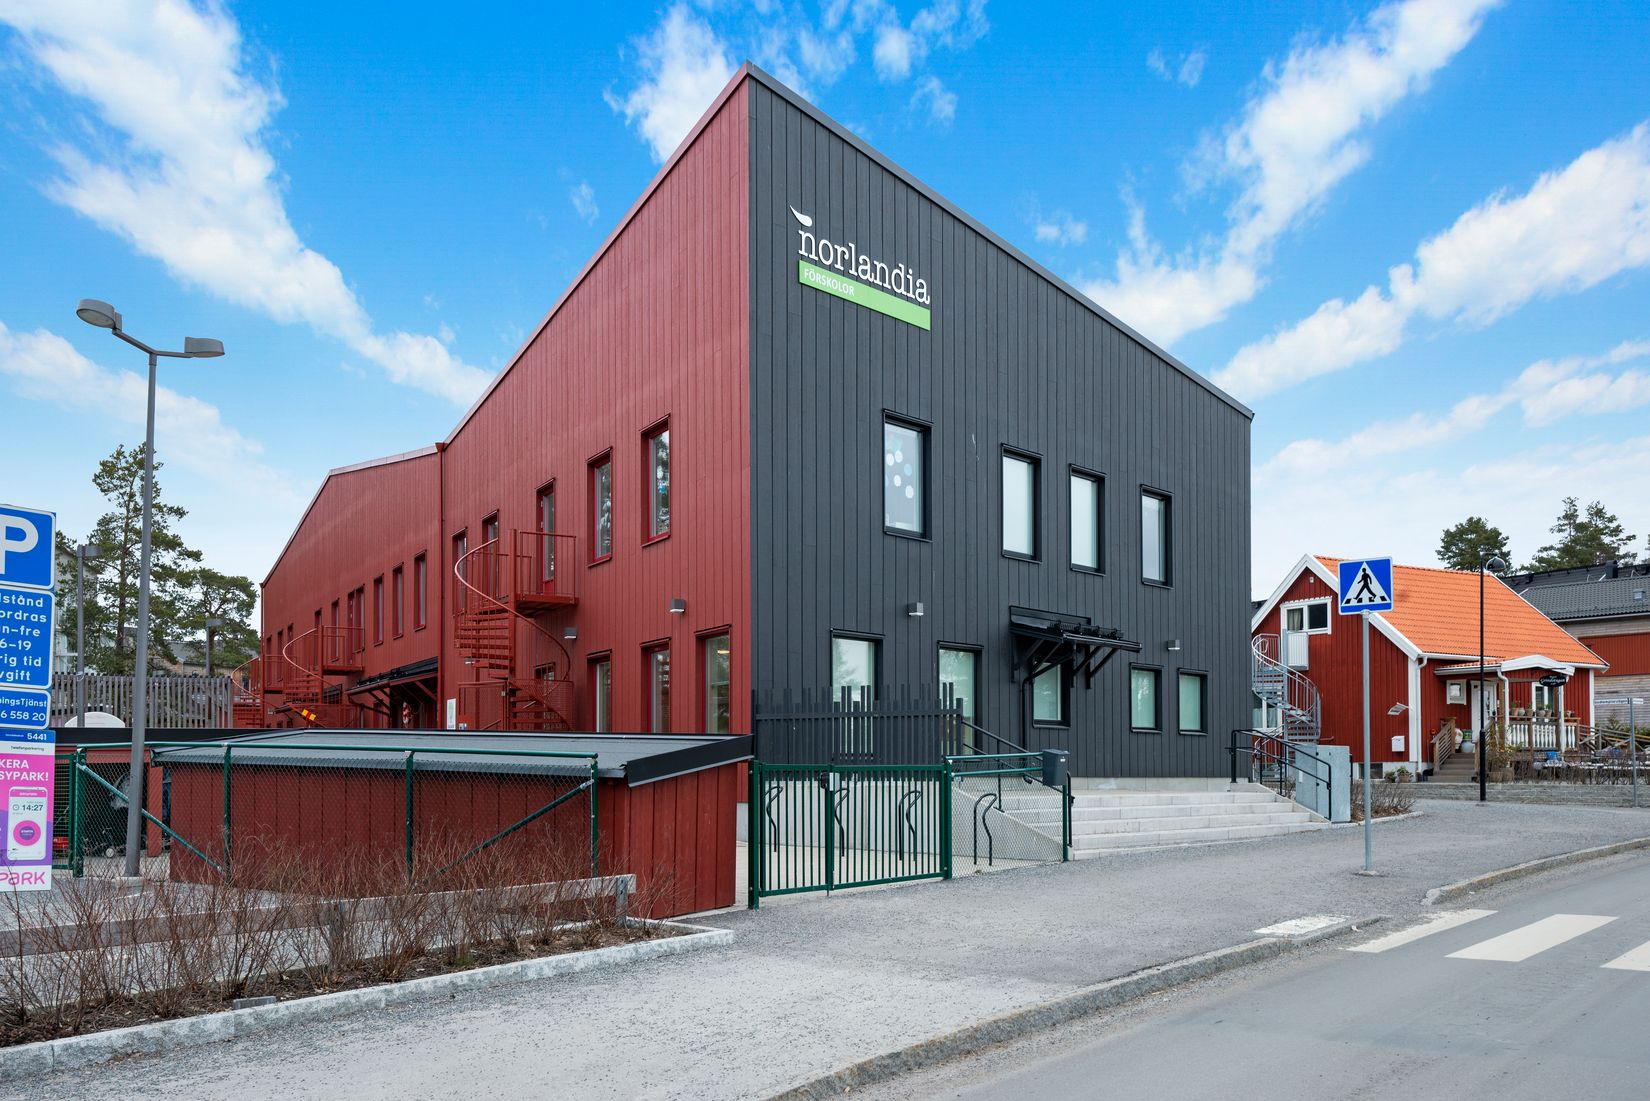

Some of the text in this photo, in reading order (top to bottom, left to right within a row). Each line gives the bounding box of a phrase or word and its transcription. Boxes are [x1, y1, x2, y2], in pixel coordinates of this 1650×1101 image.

[798, 229, 931, 305] norlandia
[803, 268, 855, 297] FÖRSKOLOR
[0, 514, 39, 575] P
[23, 656, 42, 667] tid
[10, 711, 30, 720] 558
[32, 712, 46, 721] 20
[27, 732, 47, 741] 5441
[0, 759, 29, 769] KERA
